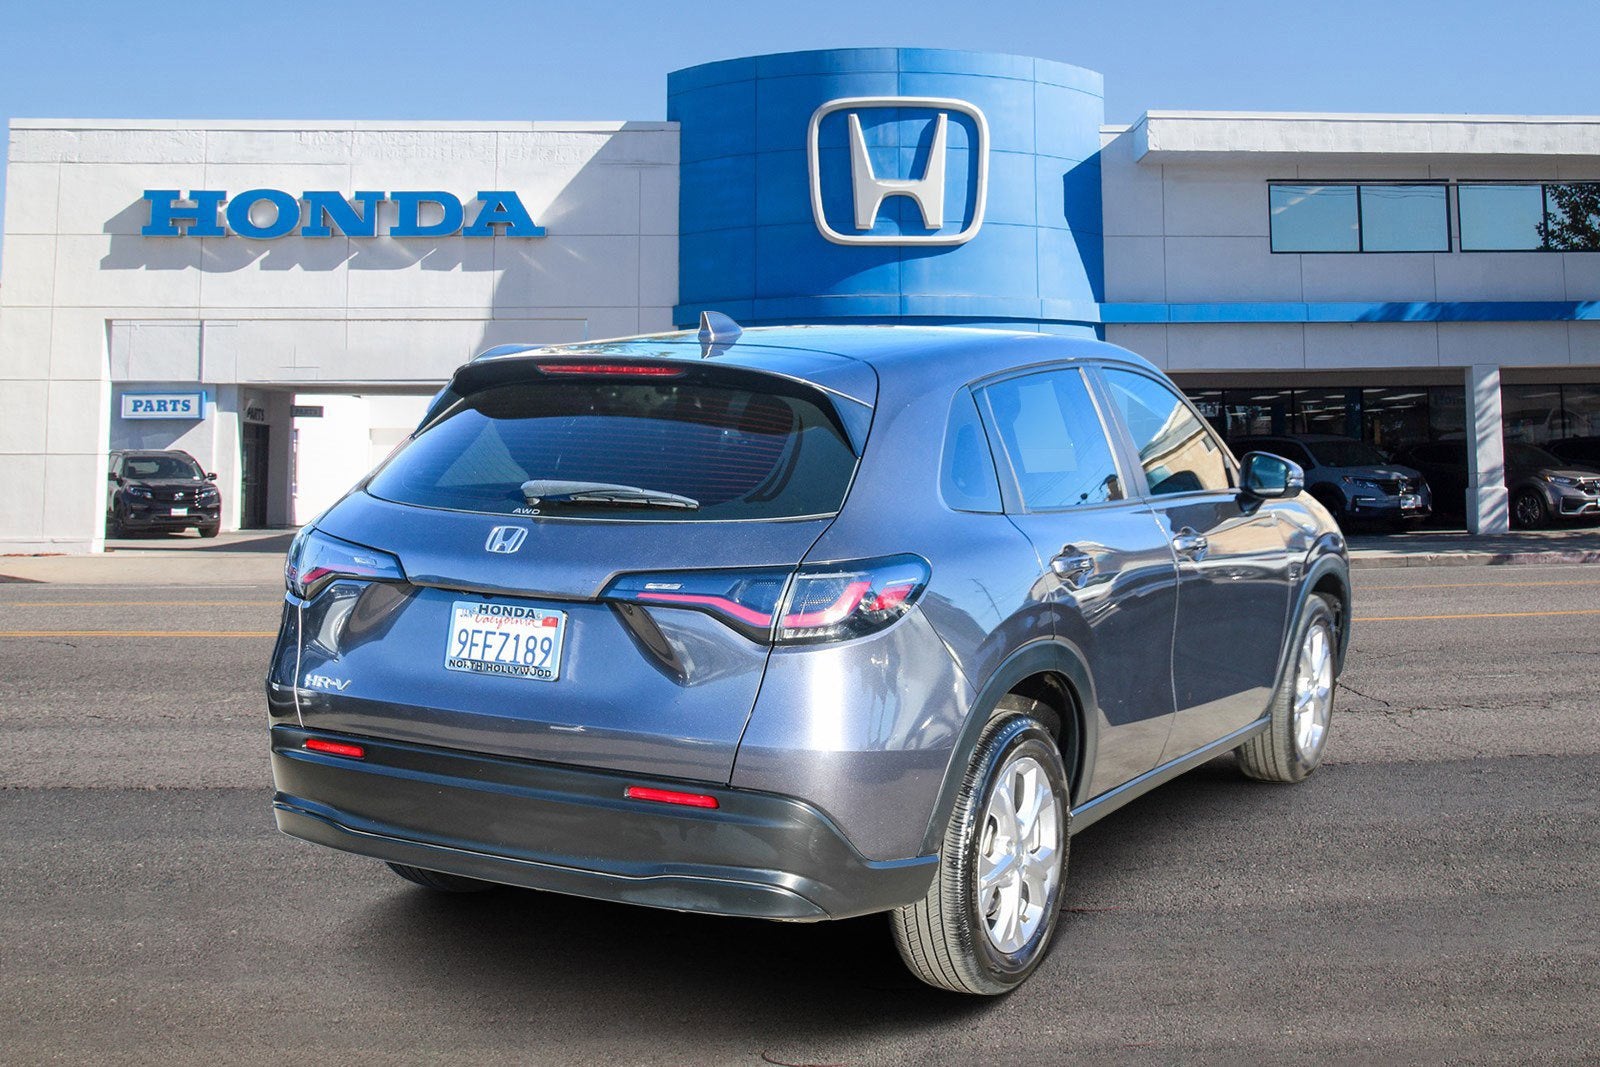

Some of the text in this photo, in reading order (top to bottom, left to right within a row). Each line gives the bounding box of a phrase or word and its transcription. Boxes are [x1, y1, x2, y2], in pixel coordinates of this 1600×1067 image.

[141, 189, 547, 240] HONDA
[132, 400, 191, 412] PARTS
[479, 605, 536, 619] HONDA
[457, 628, 552, 666] 9FFZ189
[304, 674, 351, 690] HR-V
